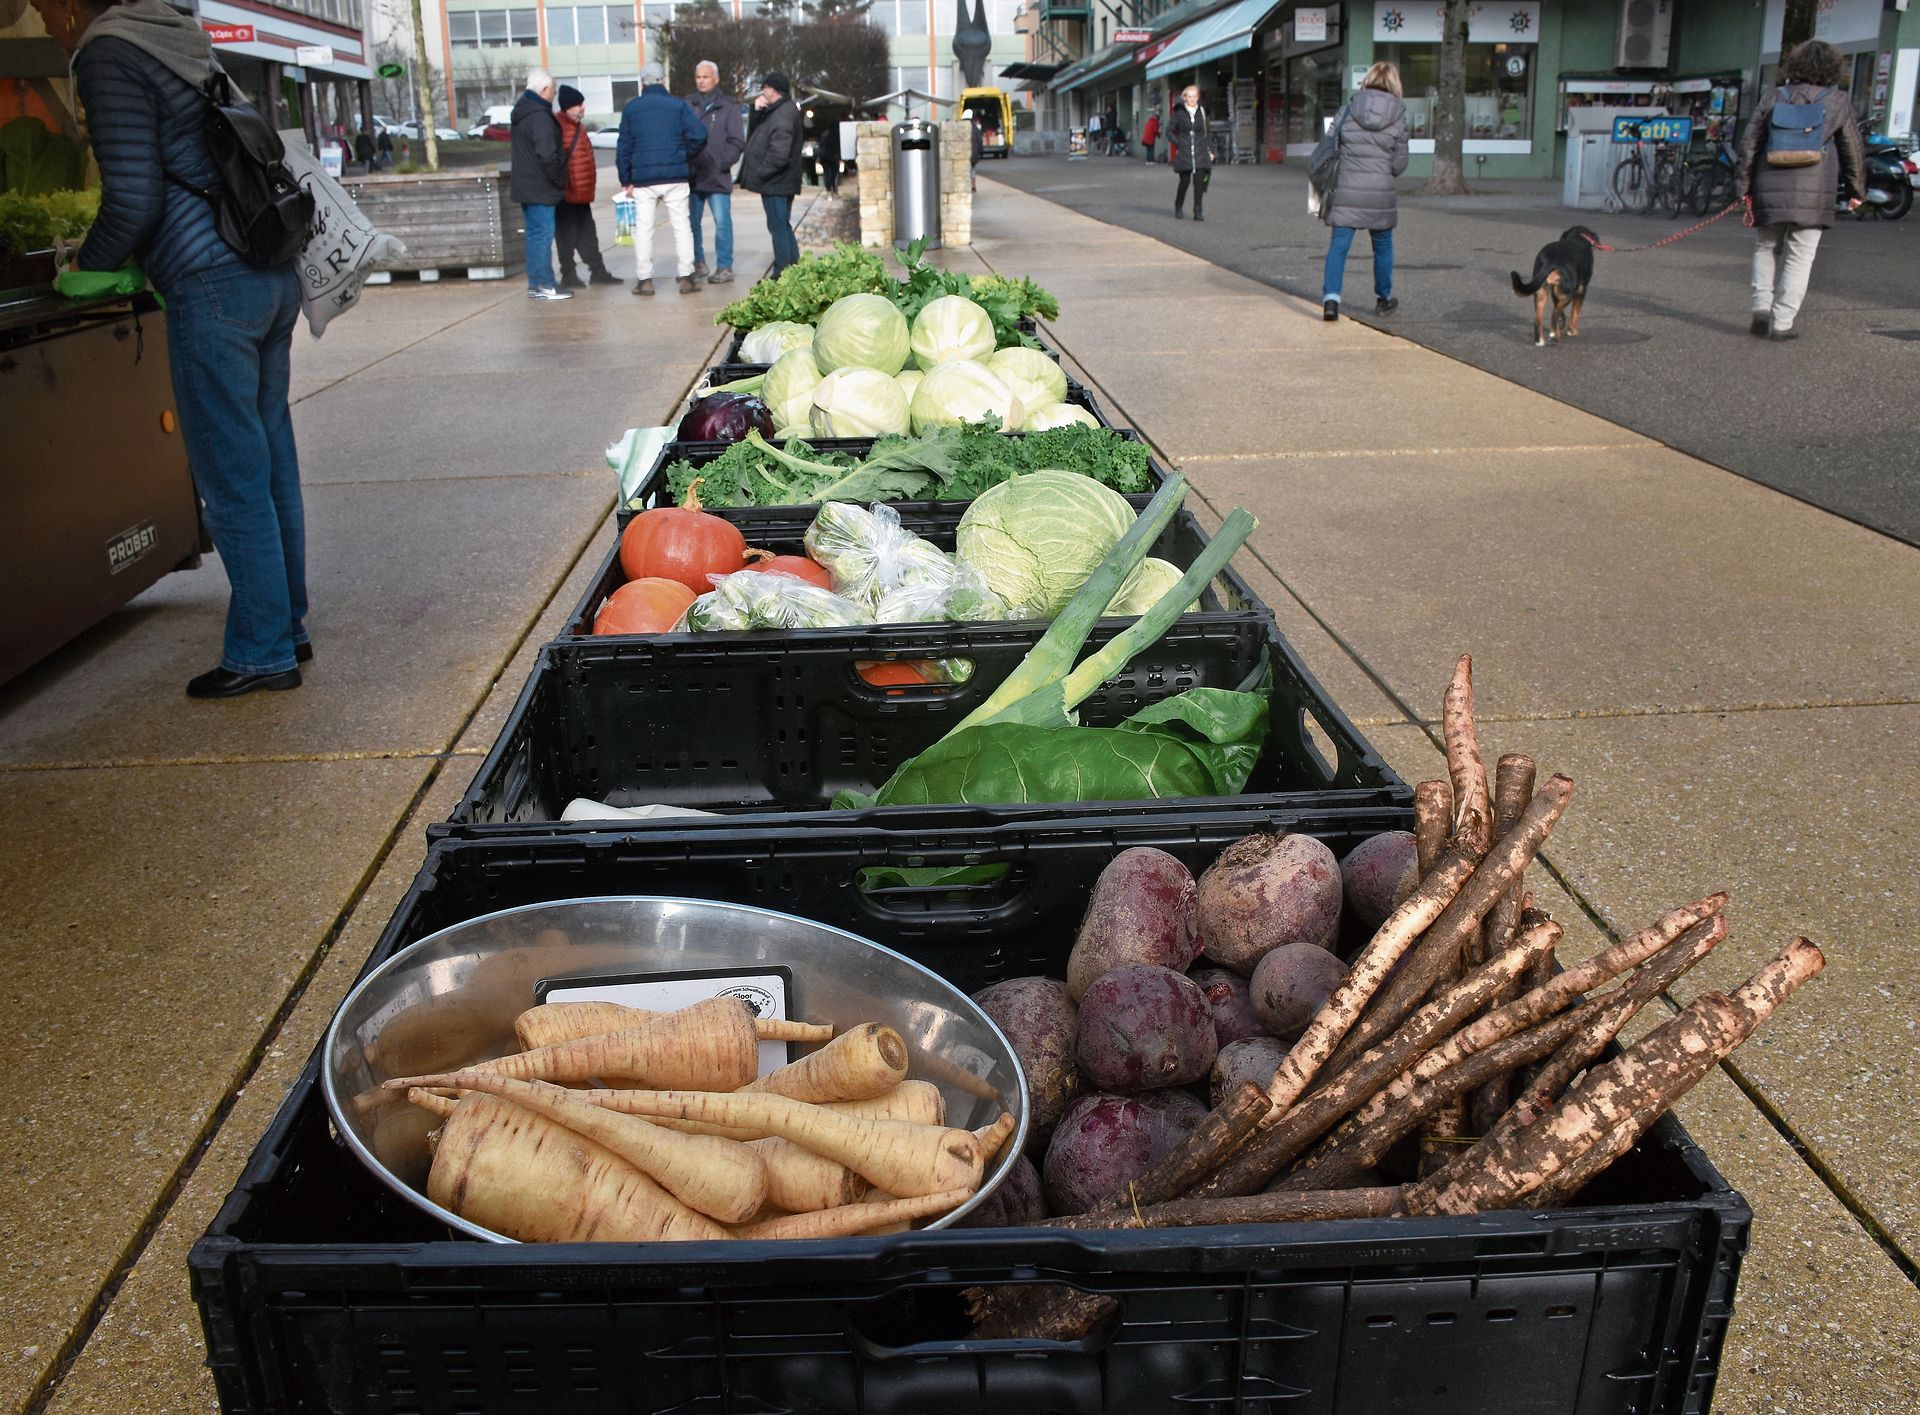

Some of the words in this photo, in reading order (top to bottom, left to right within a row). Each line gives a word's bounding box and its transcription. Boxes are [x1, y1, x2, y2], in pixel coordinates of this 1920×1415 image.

[1115, 33, 1150, 42] DENNER
[1617, 121, 1671, 139] Sath
[108, 525, 154, 566] PROBST
